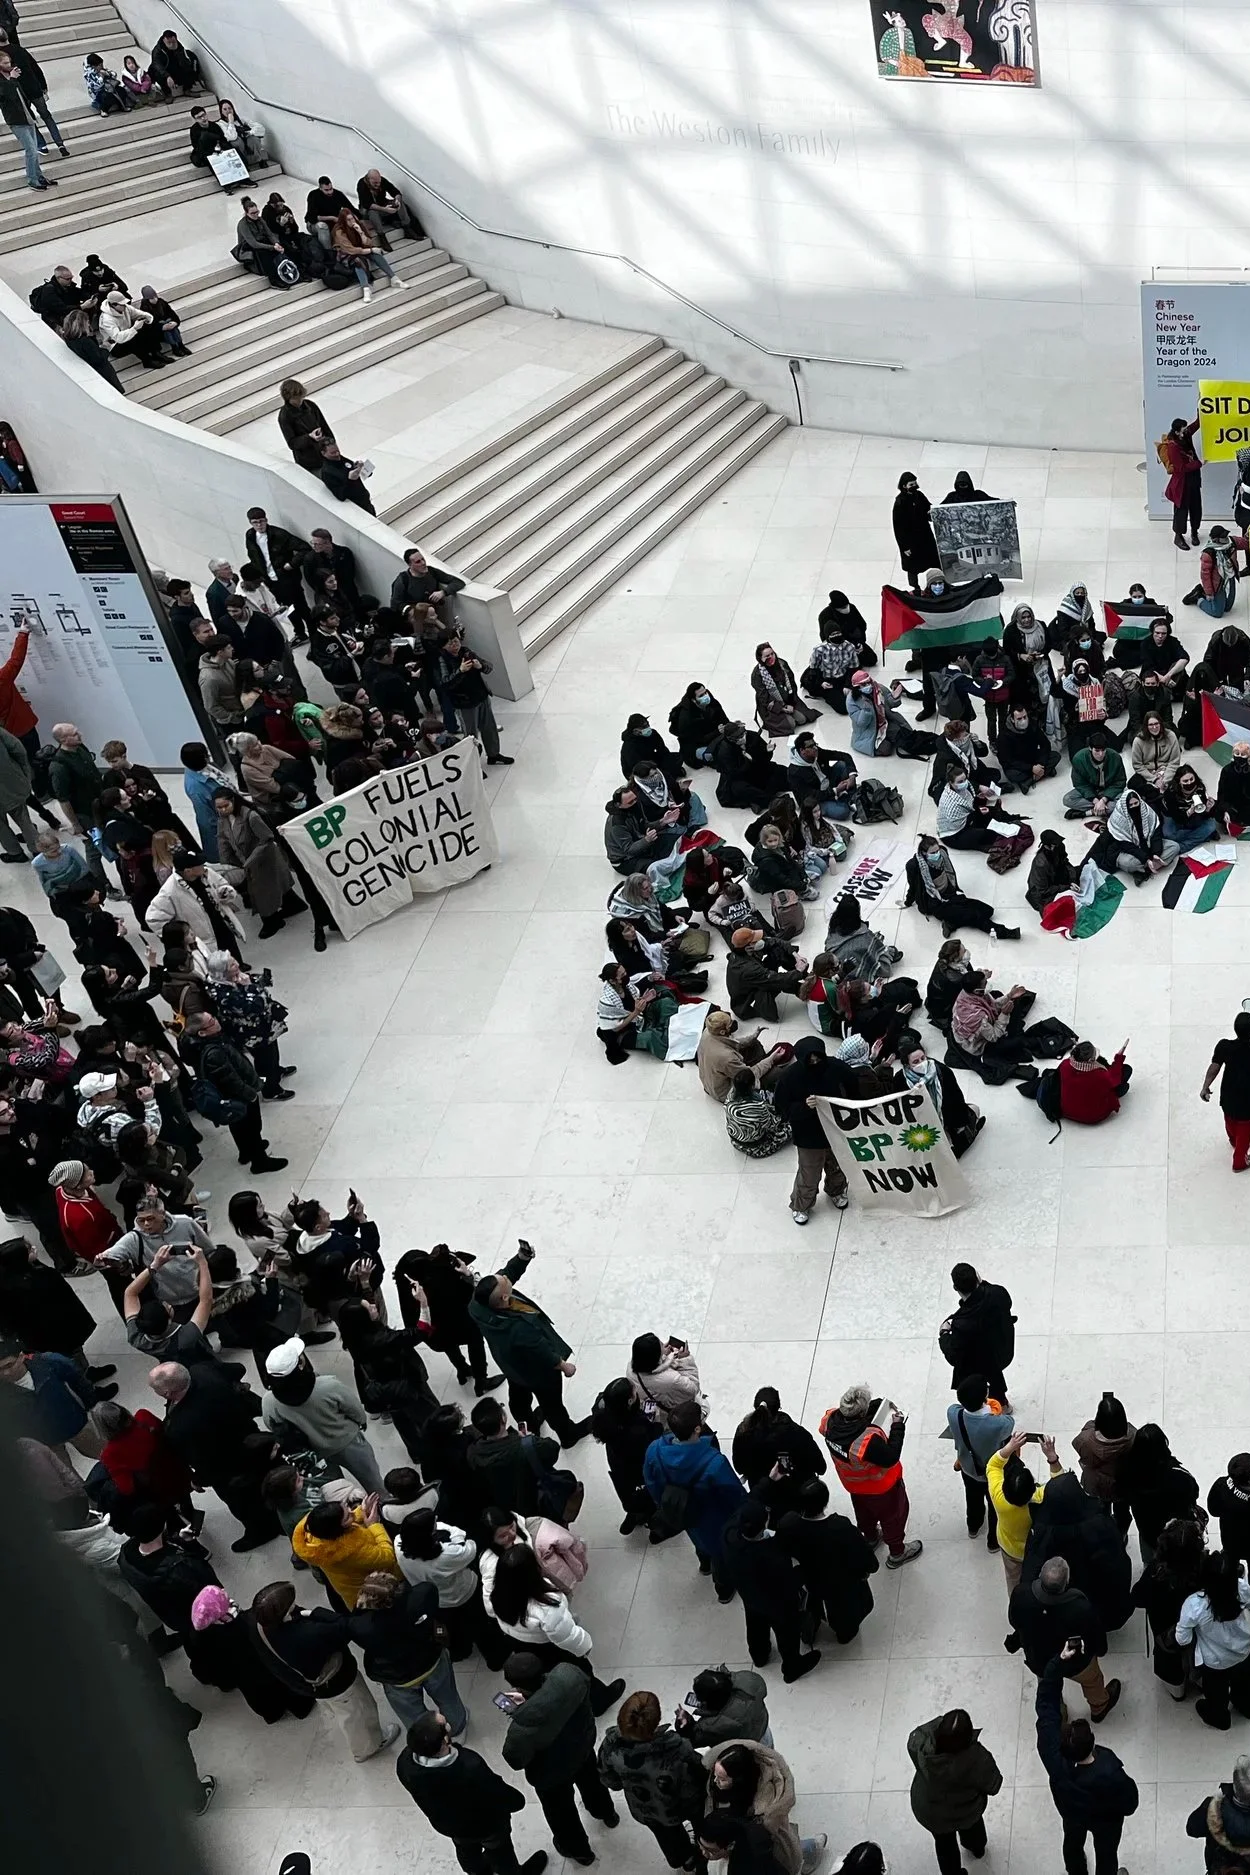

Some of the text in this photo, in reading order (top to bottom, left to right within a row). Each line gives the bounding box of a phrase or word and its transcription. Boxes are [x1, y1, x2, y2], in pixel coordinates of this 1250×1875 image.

[606, 104, 841, 164] The Weston Family
[1155, 300, 1175, 310] 春节
[1155, 312, 1195, 321] Chinese
[1156, 323, 1201, 332] New Year
[1156, 335, 1197, 345] 甲辰龙年
[1156, 346, 1208, 355] Year of the
[1156, 358, 1217, 367] Dragon 2024
[1200, 396, 1232, 415] SIT
[1085, 698, 1097, 710] FOR
[362, 753, 463, 815] FUELS
[303, 804, 347, 850] BP
[325, 791, 473, 878] COLONIAL
[342, 821, 481, 907] GENCIDE
[855, 867, 894, 901] NOW
[846, 1133, 894, 1162] BP
[862, 1162, 939, 1194] NOW
